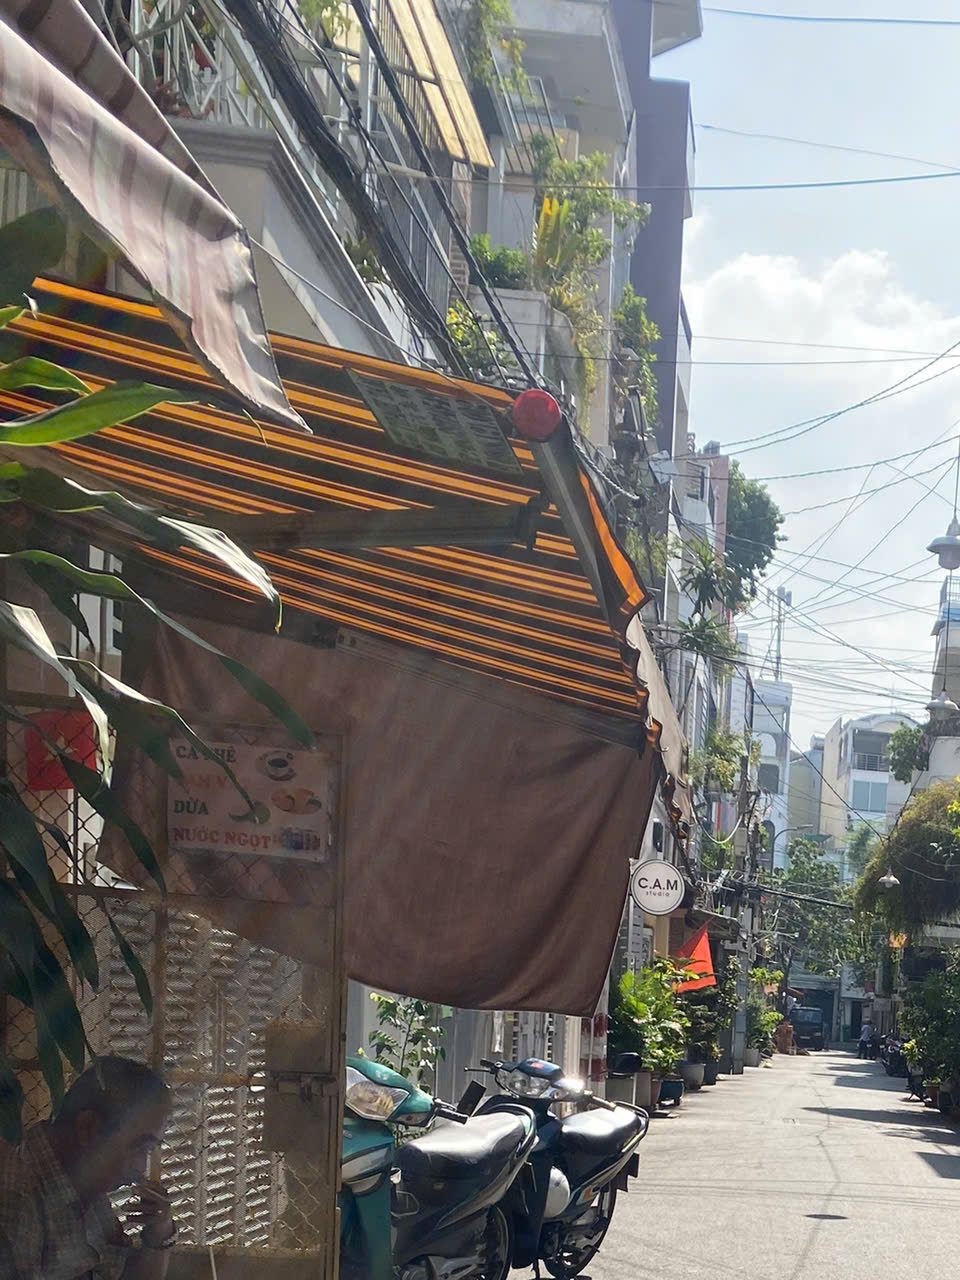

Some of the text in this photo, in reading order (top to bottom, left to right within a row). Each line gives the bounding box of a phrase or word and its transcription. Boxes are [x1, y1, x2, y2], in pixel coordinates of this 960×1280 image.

[173, 797, 209, 815] DỪA
[173, 824, 272, 851] NƯỚC NGỌT
[637, 876, 678, 891] C.A.M
